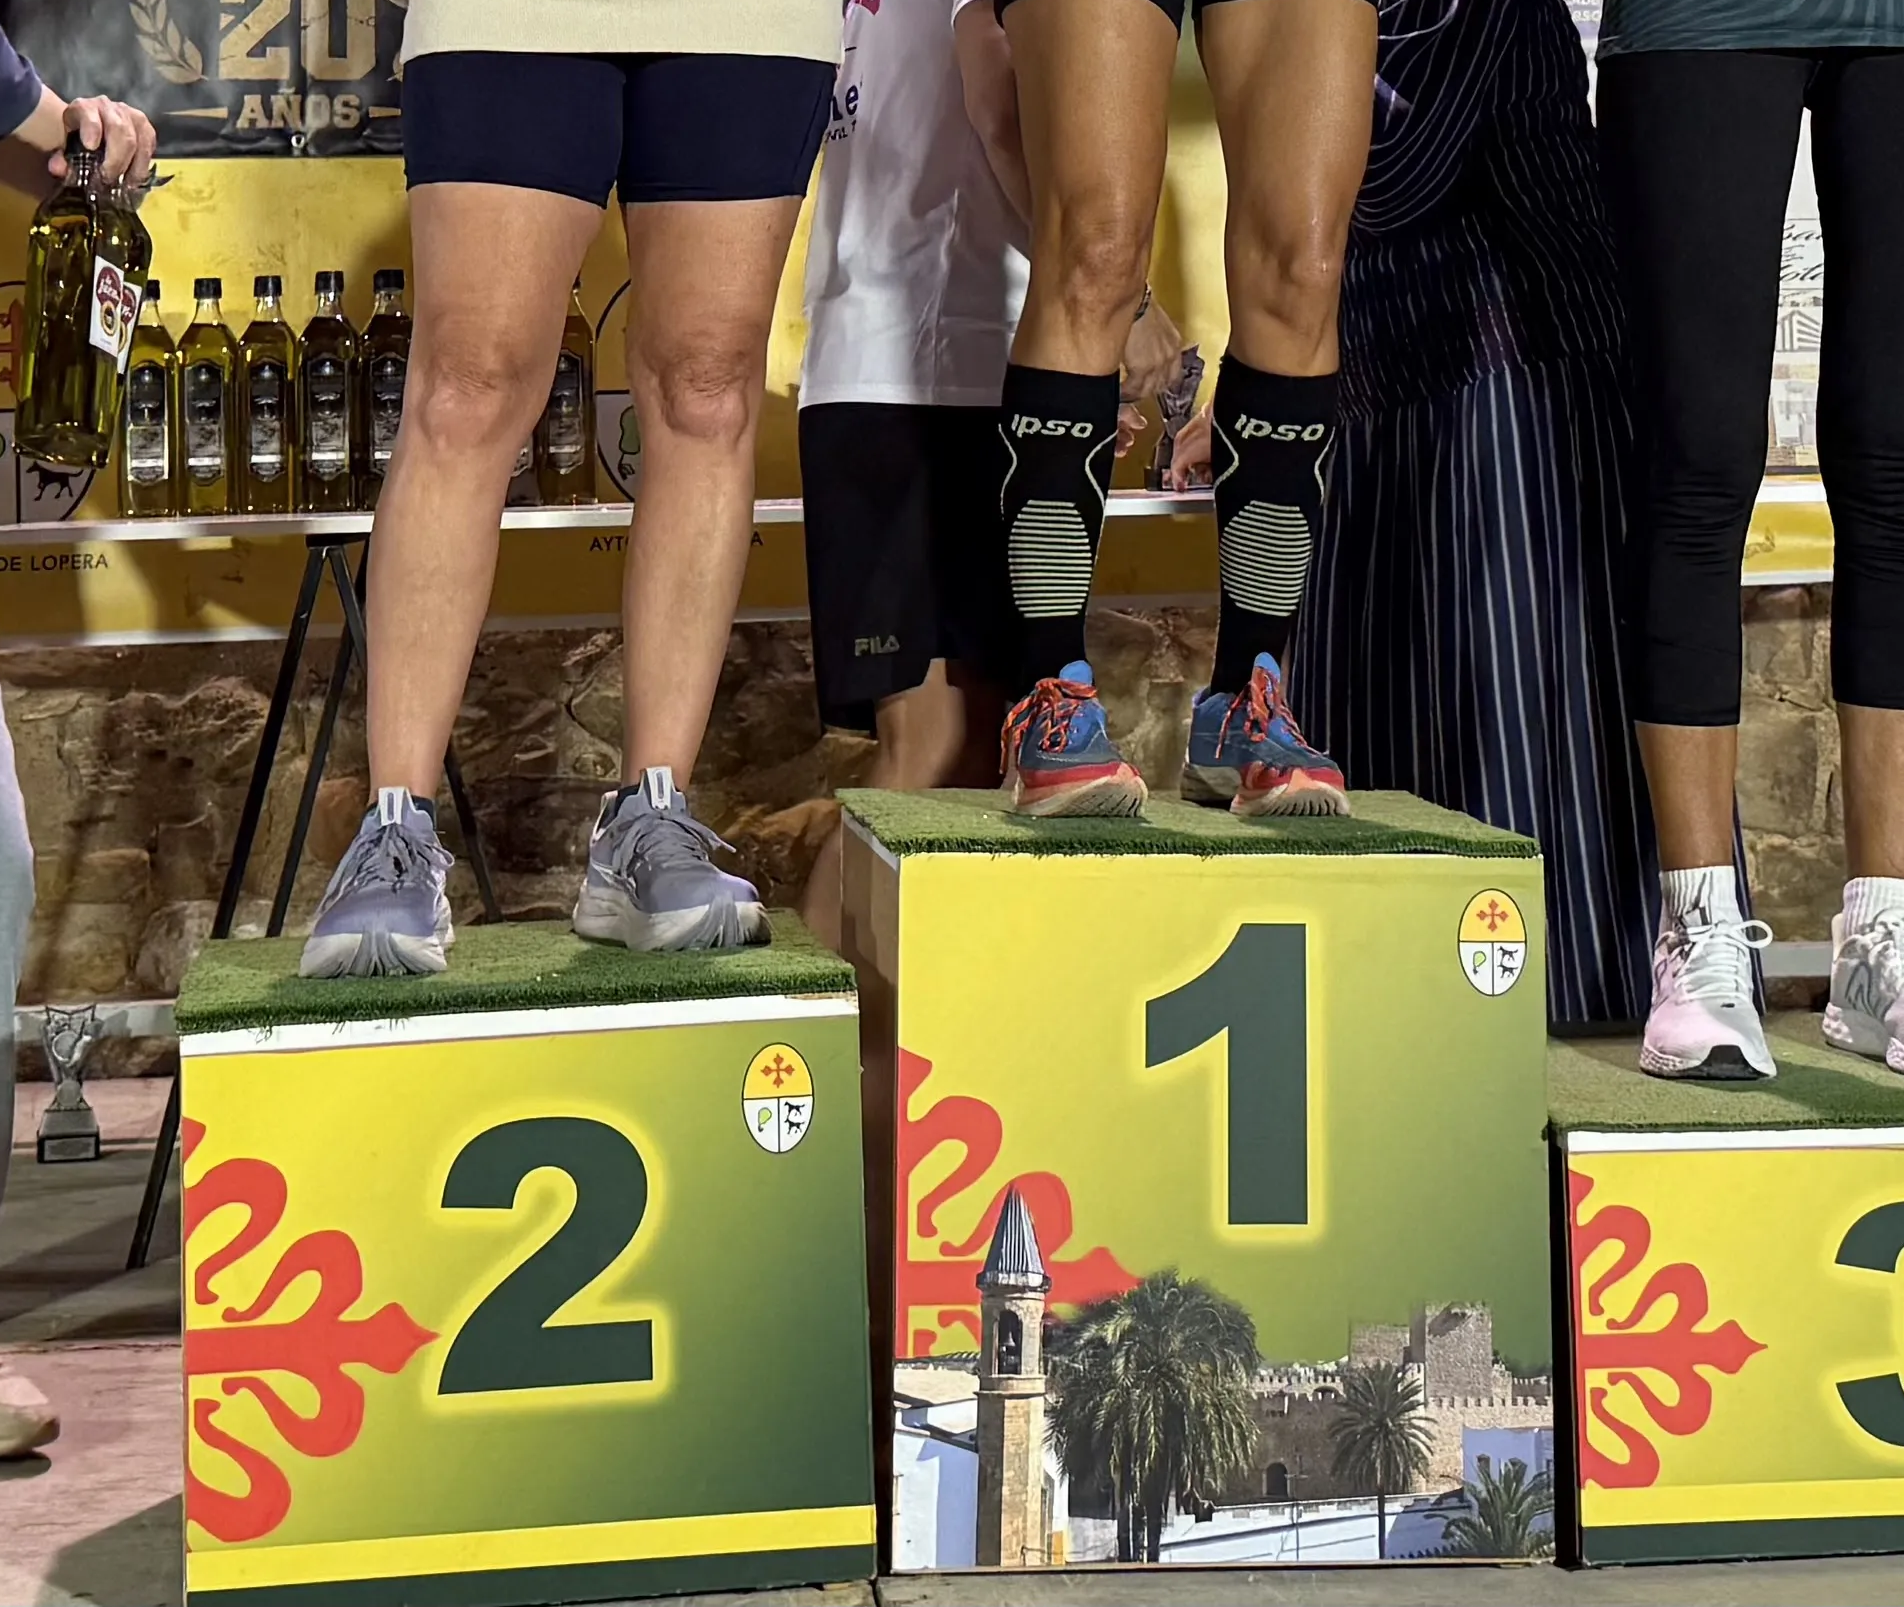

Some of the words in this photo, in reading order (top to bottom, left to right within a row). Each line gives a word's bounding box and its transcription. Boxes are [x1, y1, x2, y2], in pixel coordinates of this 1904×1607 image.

[236, 86, 360, 131] AÑOS
[31, 554, 108, 572] LOPERA
[854, 635, 900, 656] FILA
[1145, 923, 1308, 1225] 1
[437, 1116, 653, 1396] 2
